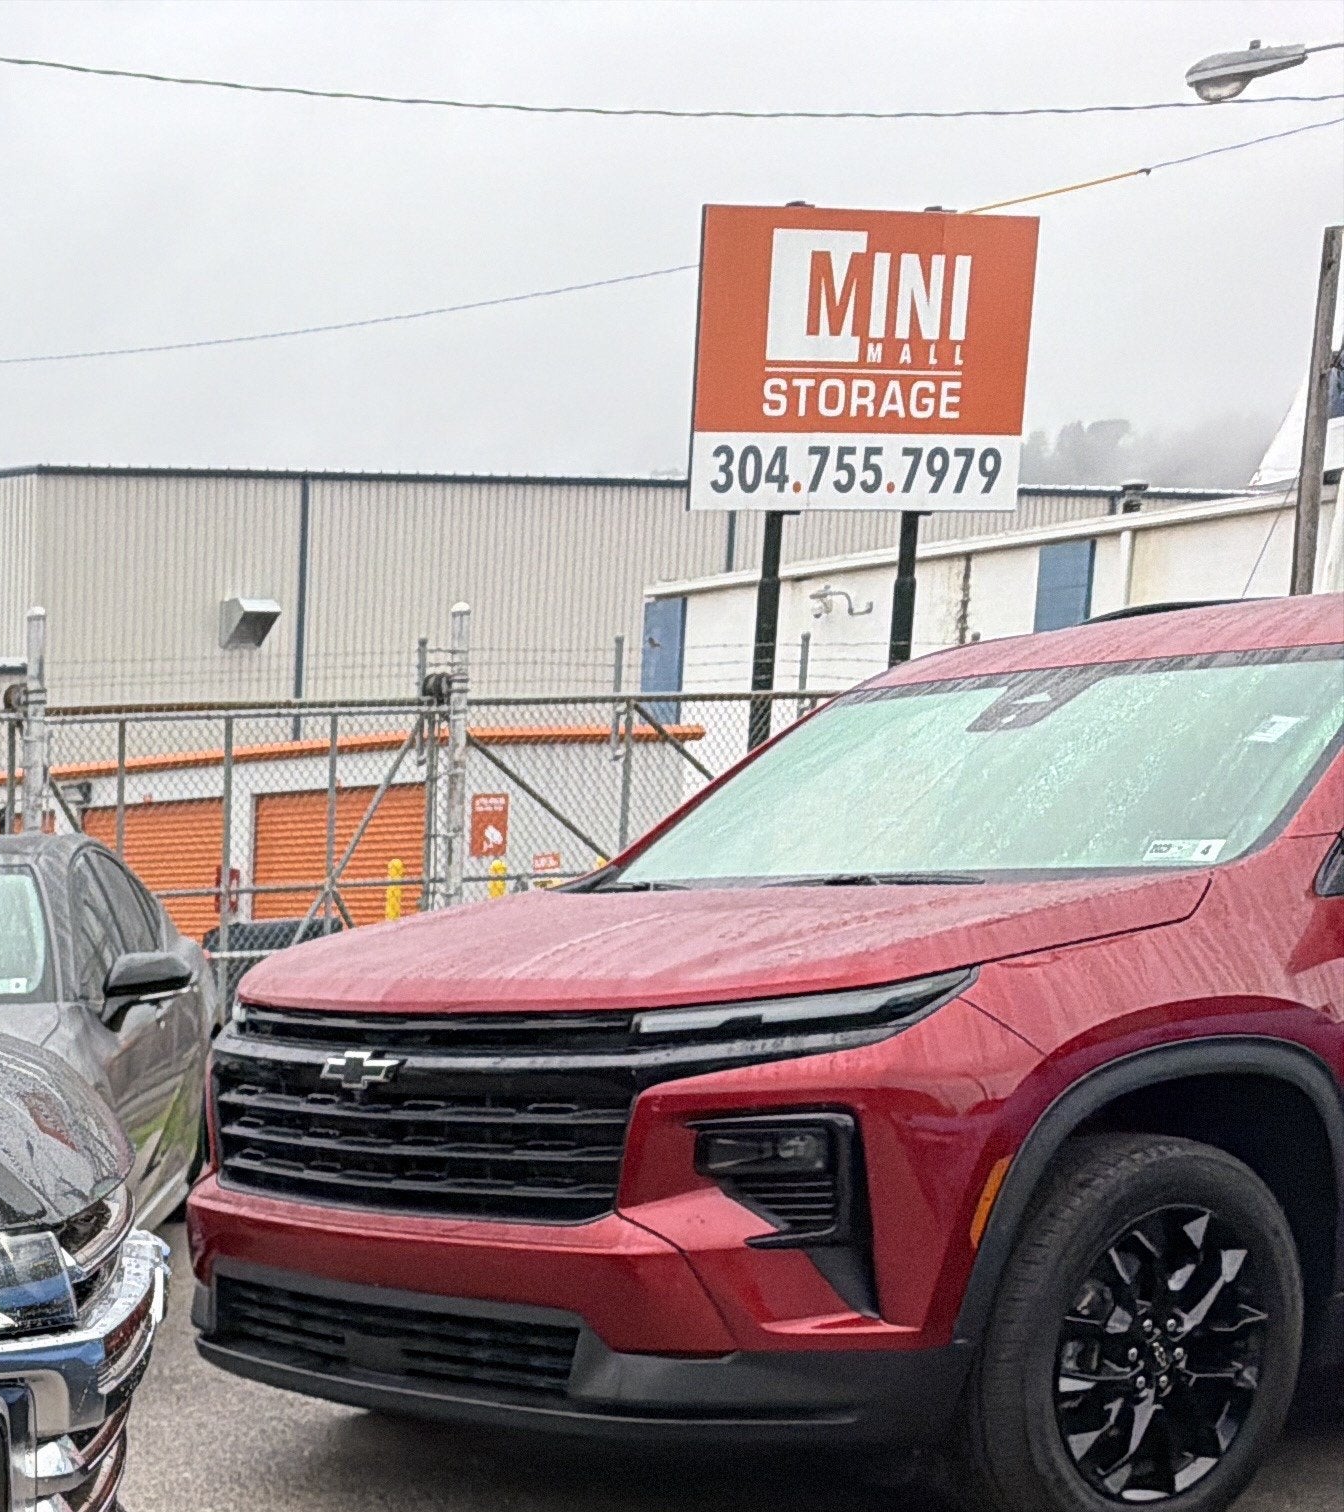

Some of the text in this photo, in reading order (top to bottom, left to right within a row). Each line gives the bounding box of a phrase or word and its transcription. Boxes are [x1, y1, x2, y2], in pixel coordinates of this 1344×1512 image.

[806, 250, 973, 341] MINI
[867, 343, 964, 366] MALL
[762, 377, 962, 419] STORAGE
[710, 444, 1002, 494] 304.755.7979
